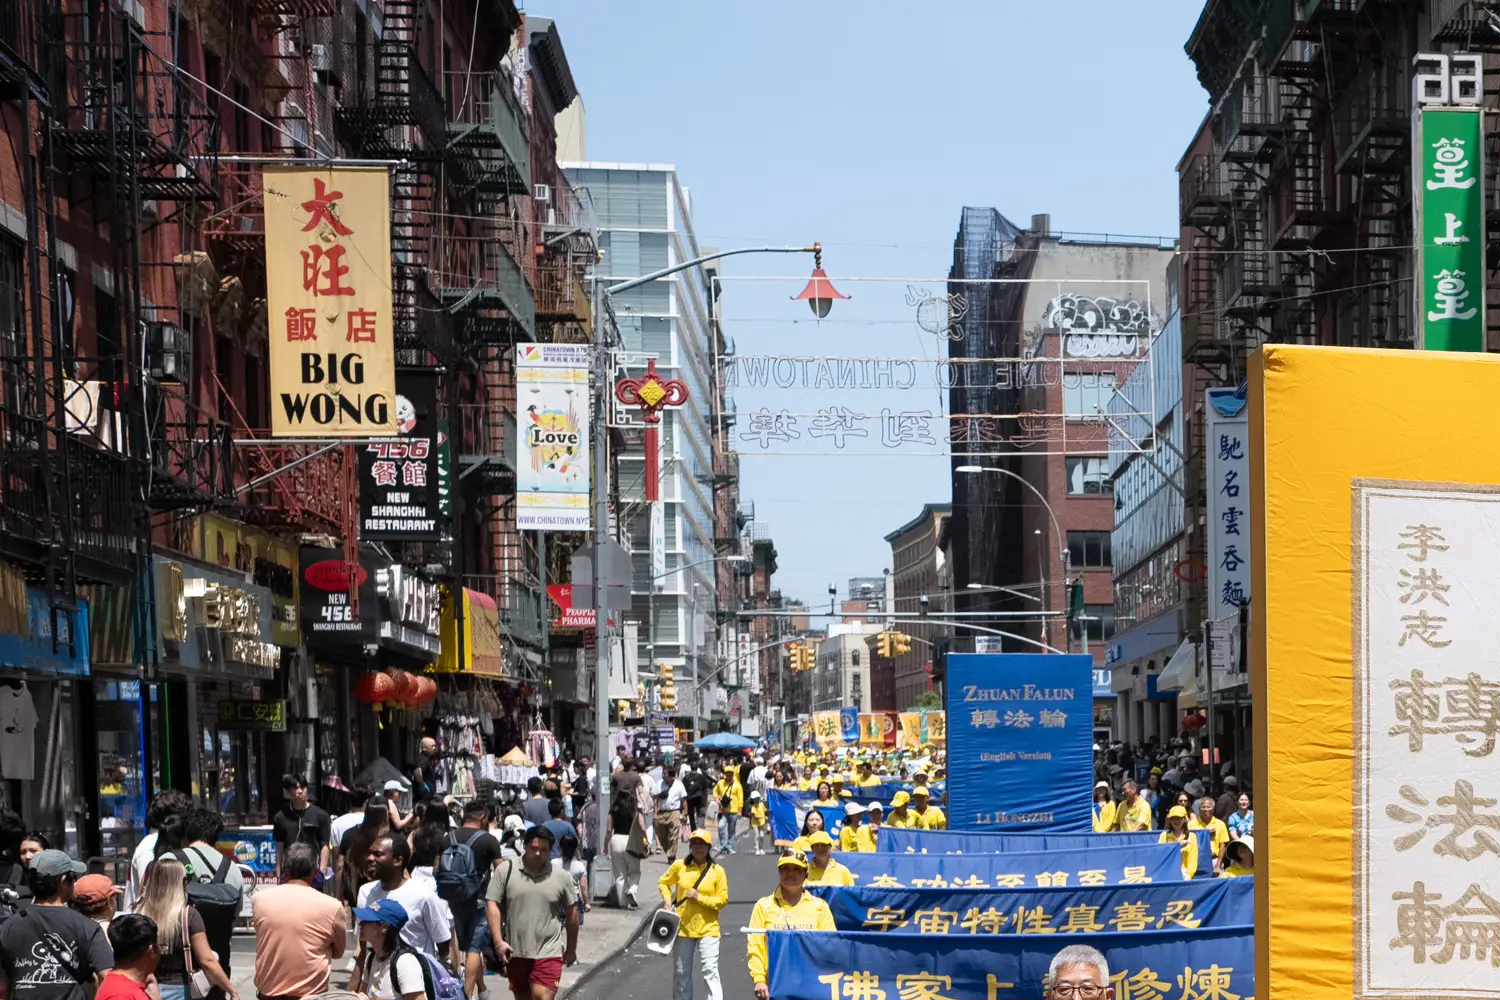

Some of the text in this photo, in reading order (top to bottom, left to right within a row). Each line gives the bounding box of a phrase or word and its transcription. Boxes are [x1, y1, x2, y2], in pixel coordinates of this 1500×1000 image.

[300, 176, 355, 297] 大旺
[285, 307, 377, 343] 飯店
[301, 353, 364, 384] BIG
[282, 393, 388, 425] WONG
[534, 429, 578, 444] Love
[366, 437, 430, 459] 456
[371, 460, 427, 487] 餐館
[387, 492, 409, 503] NEW
[365, 519, 436, 531] RESTAURANT
[518, 515, 589, 526] WWW.CHINATOWN.NYC
[1218, 434, 1245, 607] 馳名雲吞麵
[1397, 523, 1452, 648] 李洪志
[328, 593, 347, 605] NEW
[562, 616, 596, 626] PHARMA
[963, 684, 1075, 702] ZHUAN FALUN
[970, 708, 1069, 729] 轉法輪
[862, 899, 1202, 935] 宇宙特性真善忍
